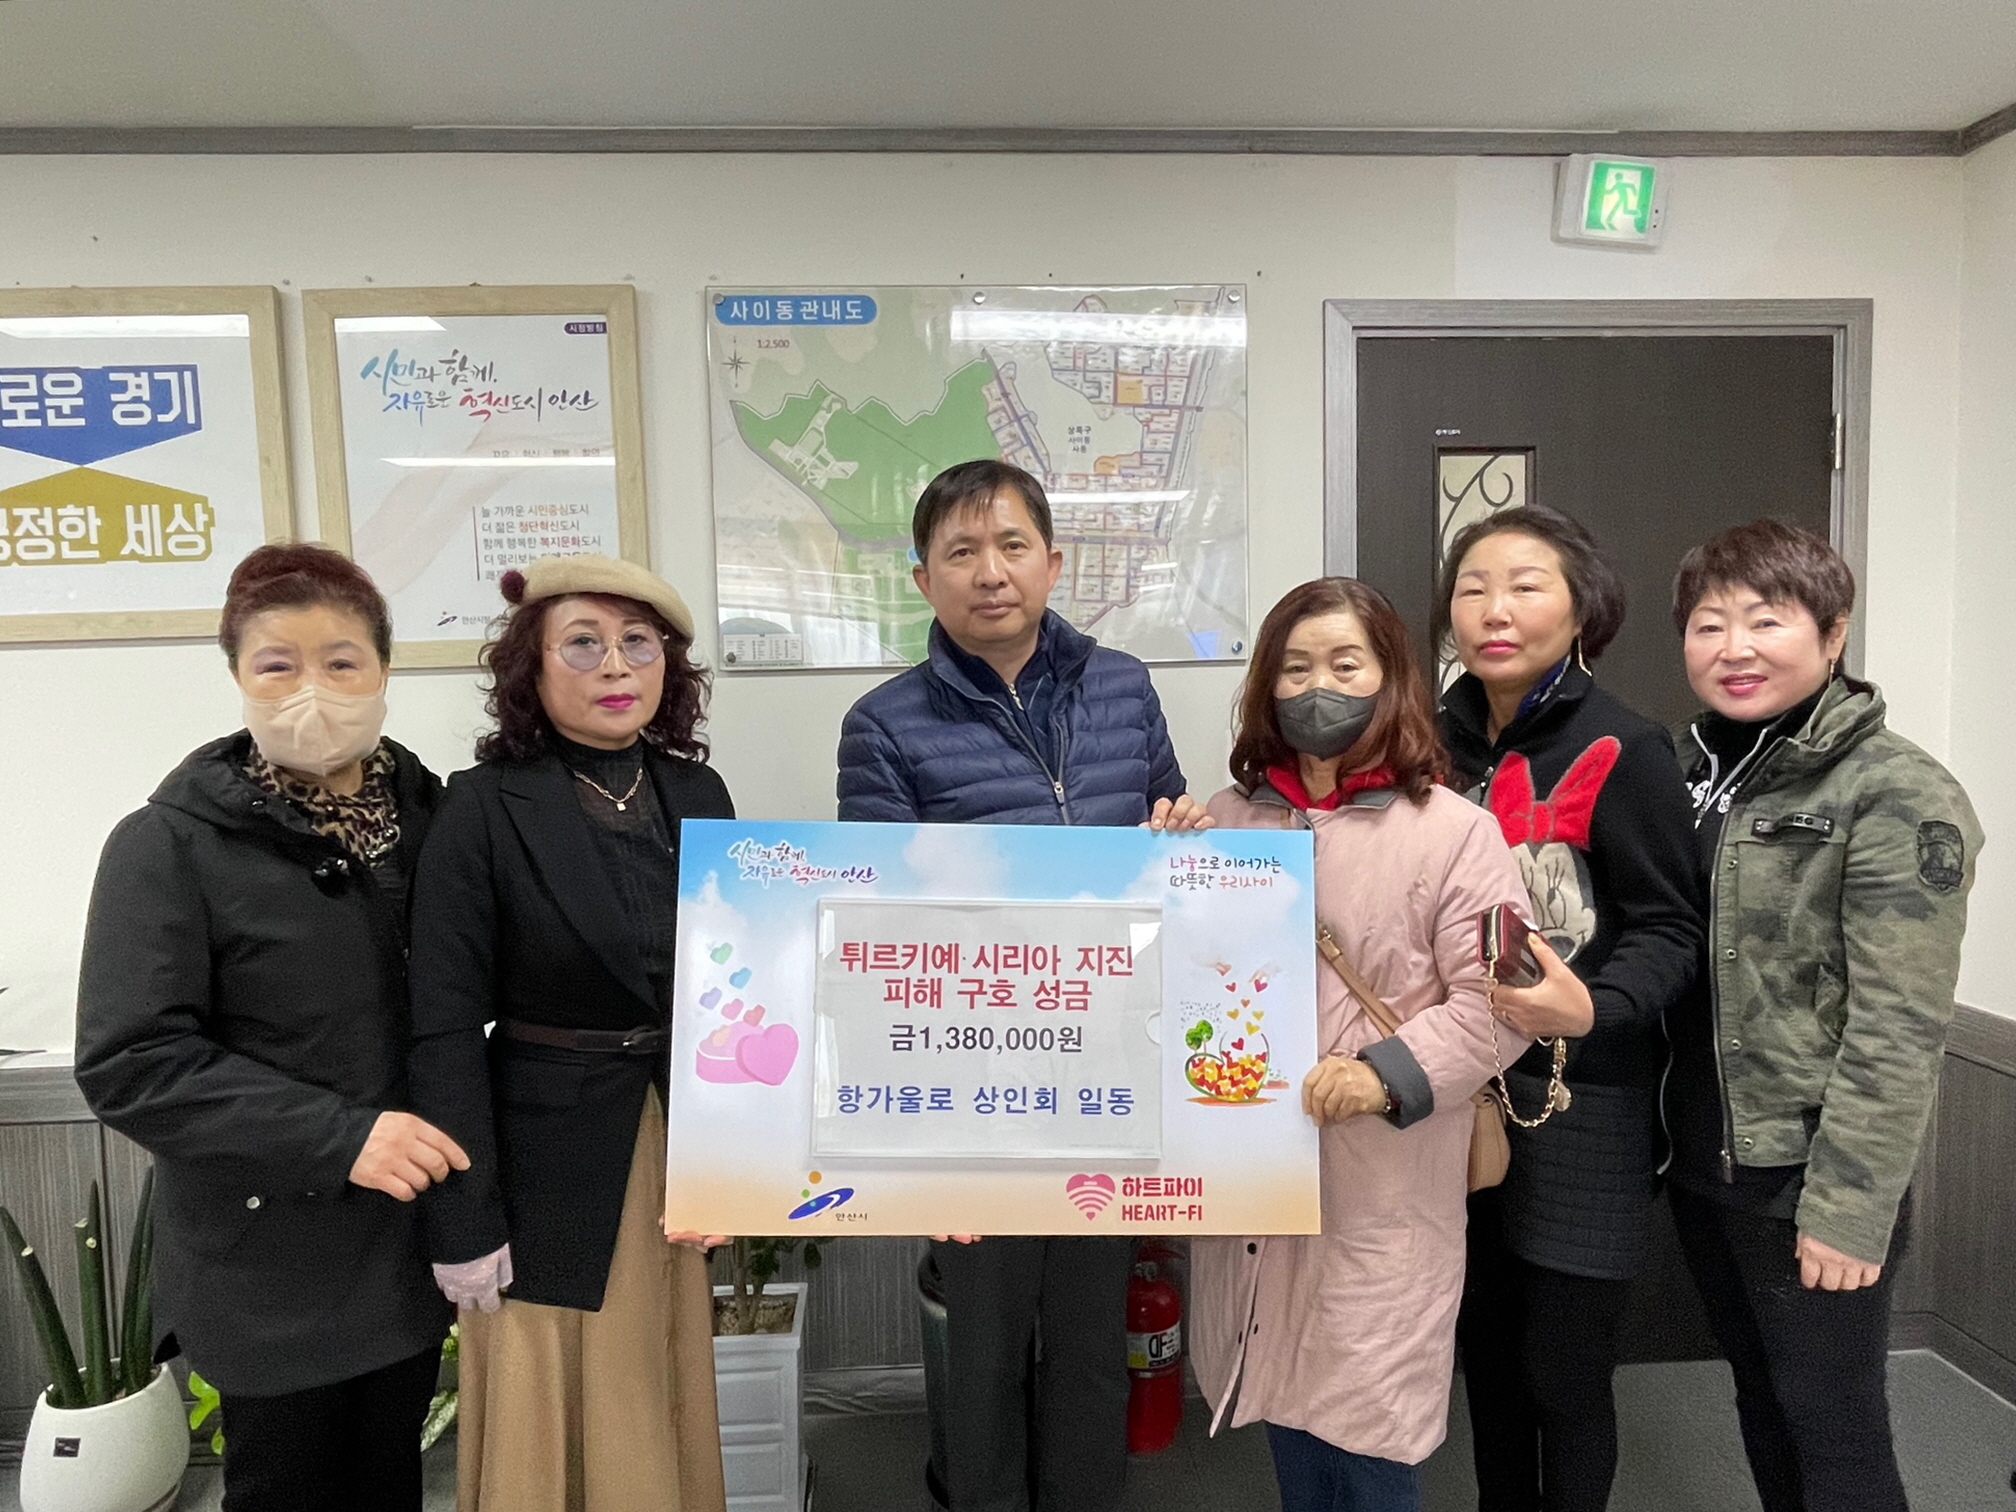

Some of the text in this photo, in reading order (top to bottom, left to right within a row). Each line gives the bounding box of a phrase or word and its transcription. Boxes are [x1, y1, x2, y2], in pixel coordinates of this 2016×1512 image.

[360, 348, 441, 396] 시민과
[0, 371, 196, 427] 로운 경기
[382, 386, 600, 427] 자유로운 혁신도시 안산
[494, 505, 525, 517] 가까운
[120, 503, 208, 557] 세상
[482, 522, 492, 533] 더
[483, 537, 504, 549] 함께
[540, 535, 602, 548] 복지문화도시
[484, 554, 494, 565] 더
[730, 840, 771, 866] 시민과
[1224, 856, 1282, 873] 이어가는
[742, 865, 878, 885] 자유로운 혁신도시 안산
[1170, 873, 1273, 891] 따뜻한 우리사이
[1075, 945, 1134, 976] 지진
[883, 977, 1092, 1012] 피해 구호 성금
[889, 1024, 1083, 1055] 금1,380,000원
[837, 1084, 1134, 1116] 항가울로 상인회 일동
[1122, 1177, 1202, 1197] 하트파이
[835, 1212, 868, 1222] 안산시
[1122, 1204, 1202, 1221] HEART-FI
